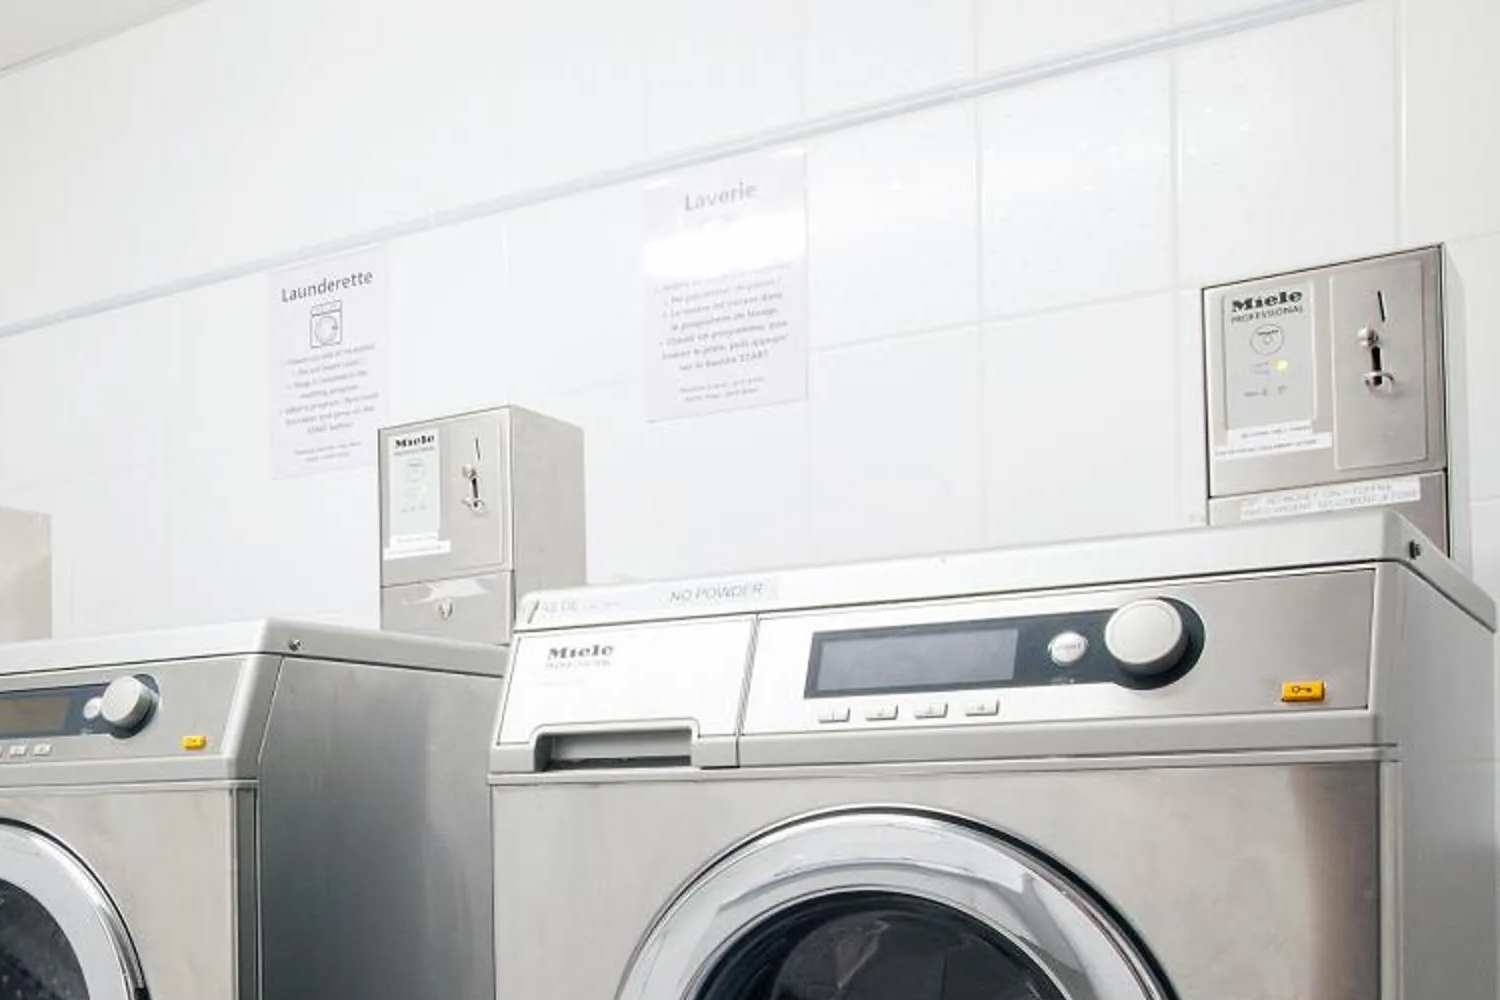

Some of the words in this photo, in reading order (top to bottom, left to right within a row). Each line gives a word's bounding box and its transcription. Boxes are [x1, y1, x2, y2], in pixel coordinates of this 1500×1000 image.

[684, 179, 758, 212] Laverie
[281, 271, 374, 304] Launderette
[1231, 291, 1303, 314] Miele
[395, 434, 435, 450] Miele
[669, 588, 693, 603] NO
[694, 582, 765, 601] POWDER
[546, 644, 614, 661] Miele
